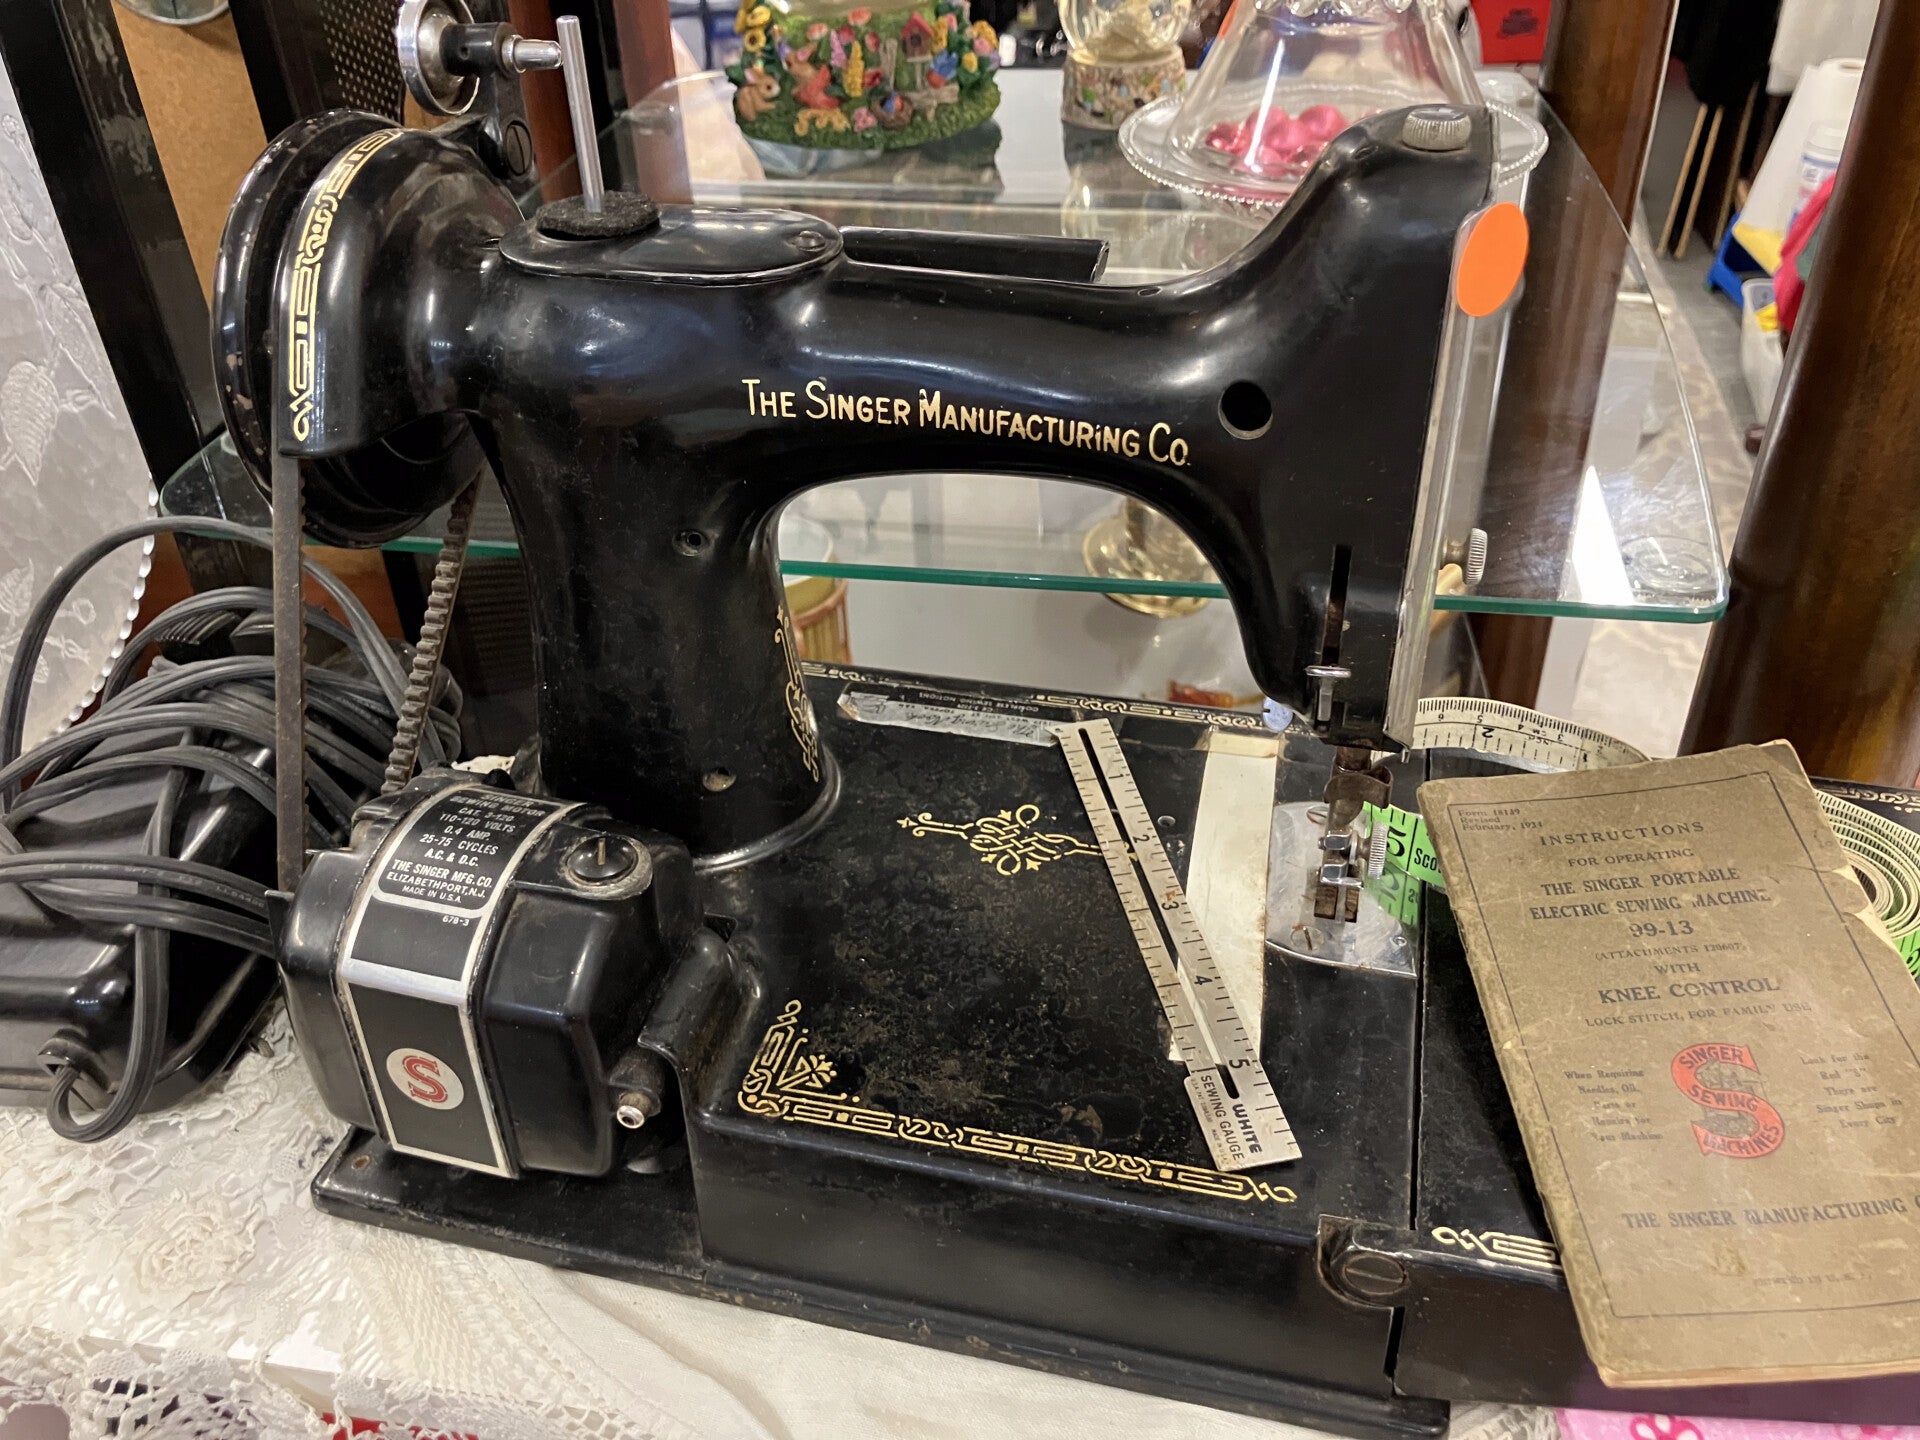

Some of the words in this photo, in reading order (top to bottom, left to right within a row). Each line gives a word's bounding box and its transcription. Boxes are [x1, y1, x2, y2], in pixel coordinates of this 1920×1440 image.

[741, 378, 797, 419] THE
[804, 379, 911, 426] SINGER
[919, 388, 1140, 459] MANUFACTURING
[1481, 726, 1496, 738] 2
[484, 820, 516, 833] VOLTS
[1539, 821, 1704, 846] INSTRUCTIONS
[419, 833, 451, 847] 25-75
[458, 840, 499, 855] CYCLES
[1133, 834, 1150, 844] 2
[446, 852, 456, 862] &
[458, 855, 479, 867] D.C.
[1414, 848, 1441, 873] SCO
[1568, 857, 1598, 867] FOR
[1604, 848, 1694, 865] OPERATING
[391, 859, 413, 872] THE
[413, 863, 450, 879] SINGER
[402, 885, 427, 896] MADE
[427, 890, 438, 898] IN
[1540, 882, 1576, 896] THE
[1583, 876, 1644, 893] SINGER
[1652, 868, 1741, 887] PORTABLE
[1161, 901, 1179, 911] 3
[1529, 902, 1609, 920] ELECTRIC
[1616, 896, 1682, 913] SEWING
[1629, 920, 1694, 938] 99-13
[1654, 962, 1700, 975] WITH
[1194, 975, 1212, 986] 4
[1598, 985, 1661, 1004] KNEE
[1668, 977, 1780, 998] CONTROL
[1585, 1016, 1624, 1027] LOCK
[1688, 1008, 1717, 1020] FOR
[1229, 1058, 1250, 1069] 5
[1679, 1046, 1744, 1069] SINGER
[402, 1055, 449, 1104] S
[1687, 1084, 1758, 1112] SEWING
[1201, 1075, 1227, 1118] SEWING
[1220, 1121, 1245, 1160] GAUGE
[1232, 1103, 1263, 1154] WHITE
[1622, 1212, 1661, 1229] THE
[1668, 1210, 1737, 1228] SINGER
